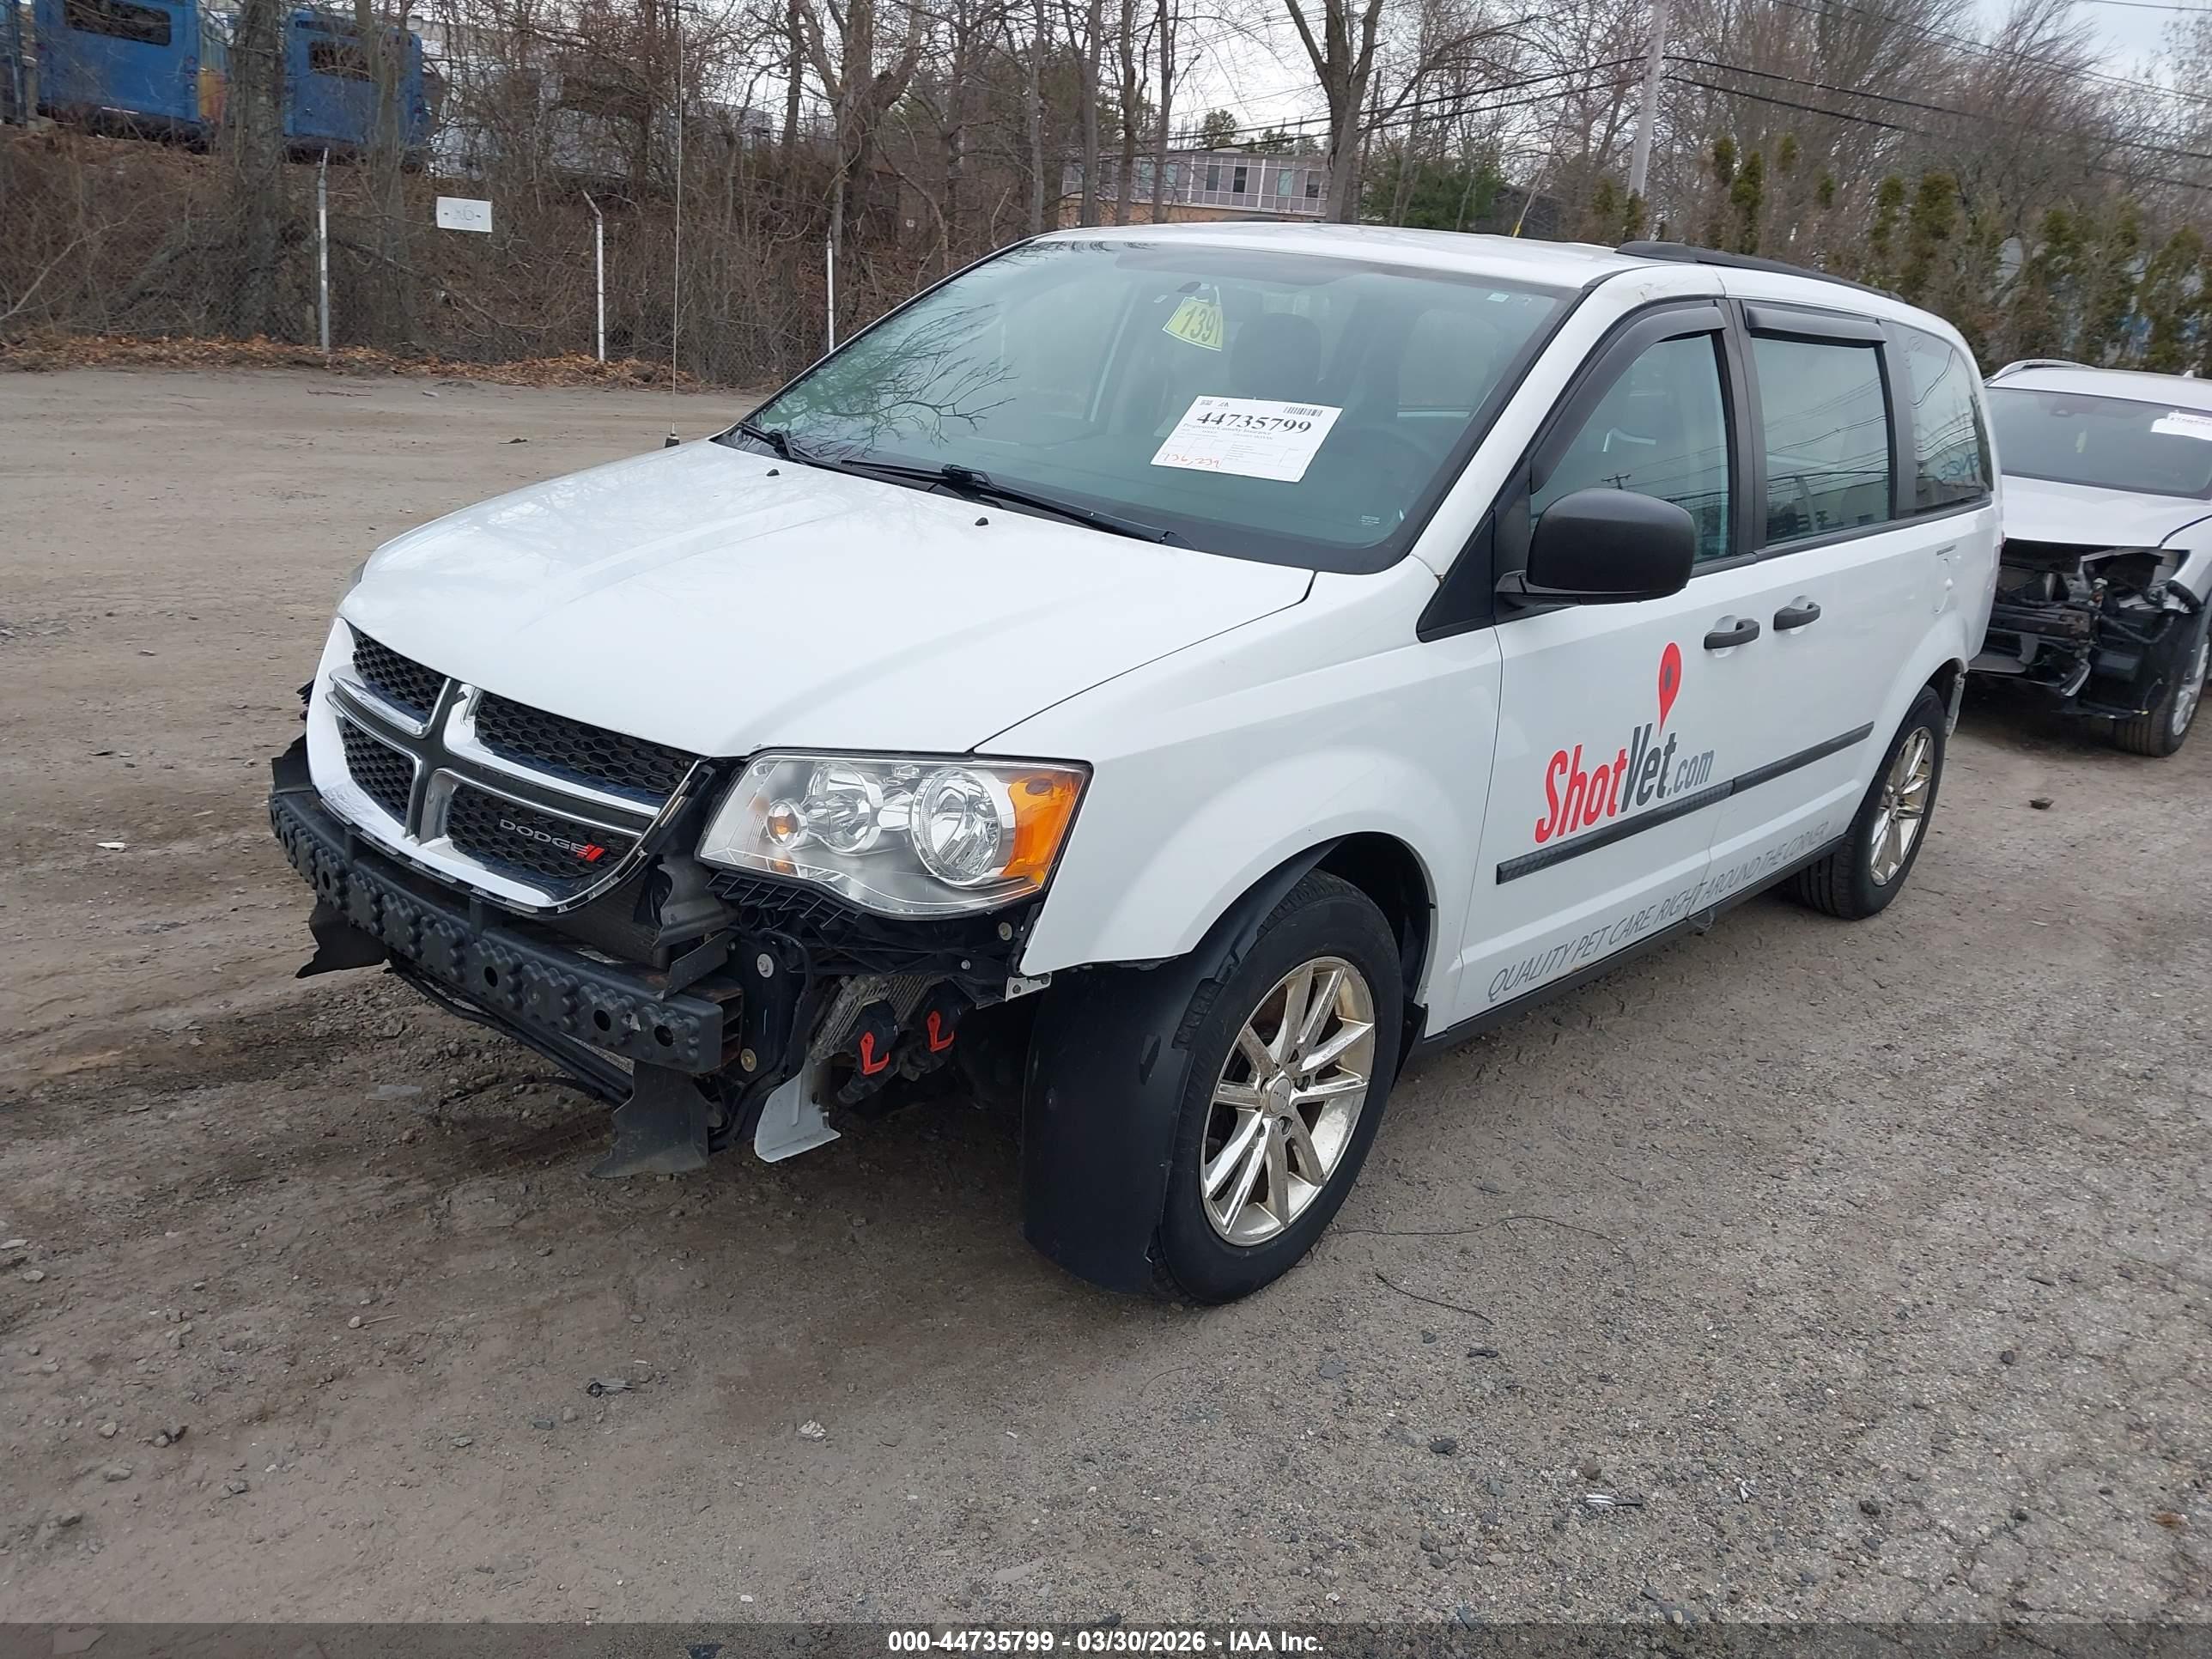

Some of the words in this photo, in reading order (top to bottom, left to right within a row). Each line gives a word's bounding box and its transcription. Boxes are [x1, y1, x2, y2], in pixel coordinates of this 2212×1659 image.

[1196, 411, 1311, 434] 44735799
[1534, 723, 1714, 843] ShotVet.com
[500, 818, 588, 856] DODGE
[1488, 939, 1576, 1003] QUALITY
[1571, 925, 1612, 963] PET
[1608, 904, 1657, 945] CARE
[1654, 879, 1707, 924] RIGHT
[1698, 856, 1761, 899] AROUND
